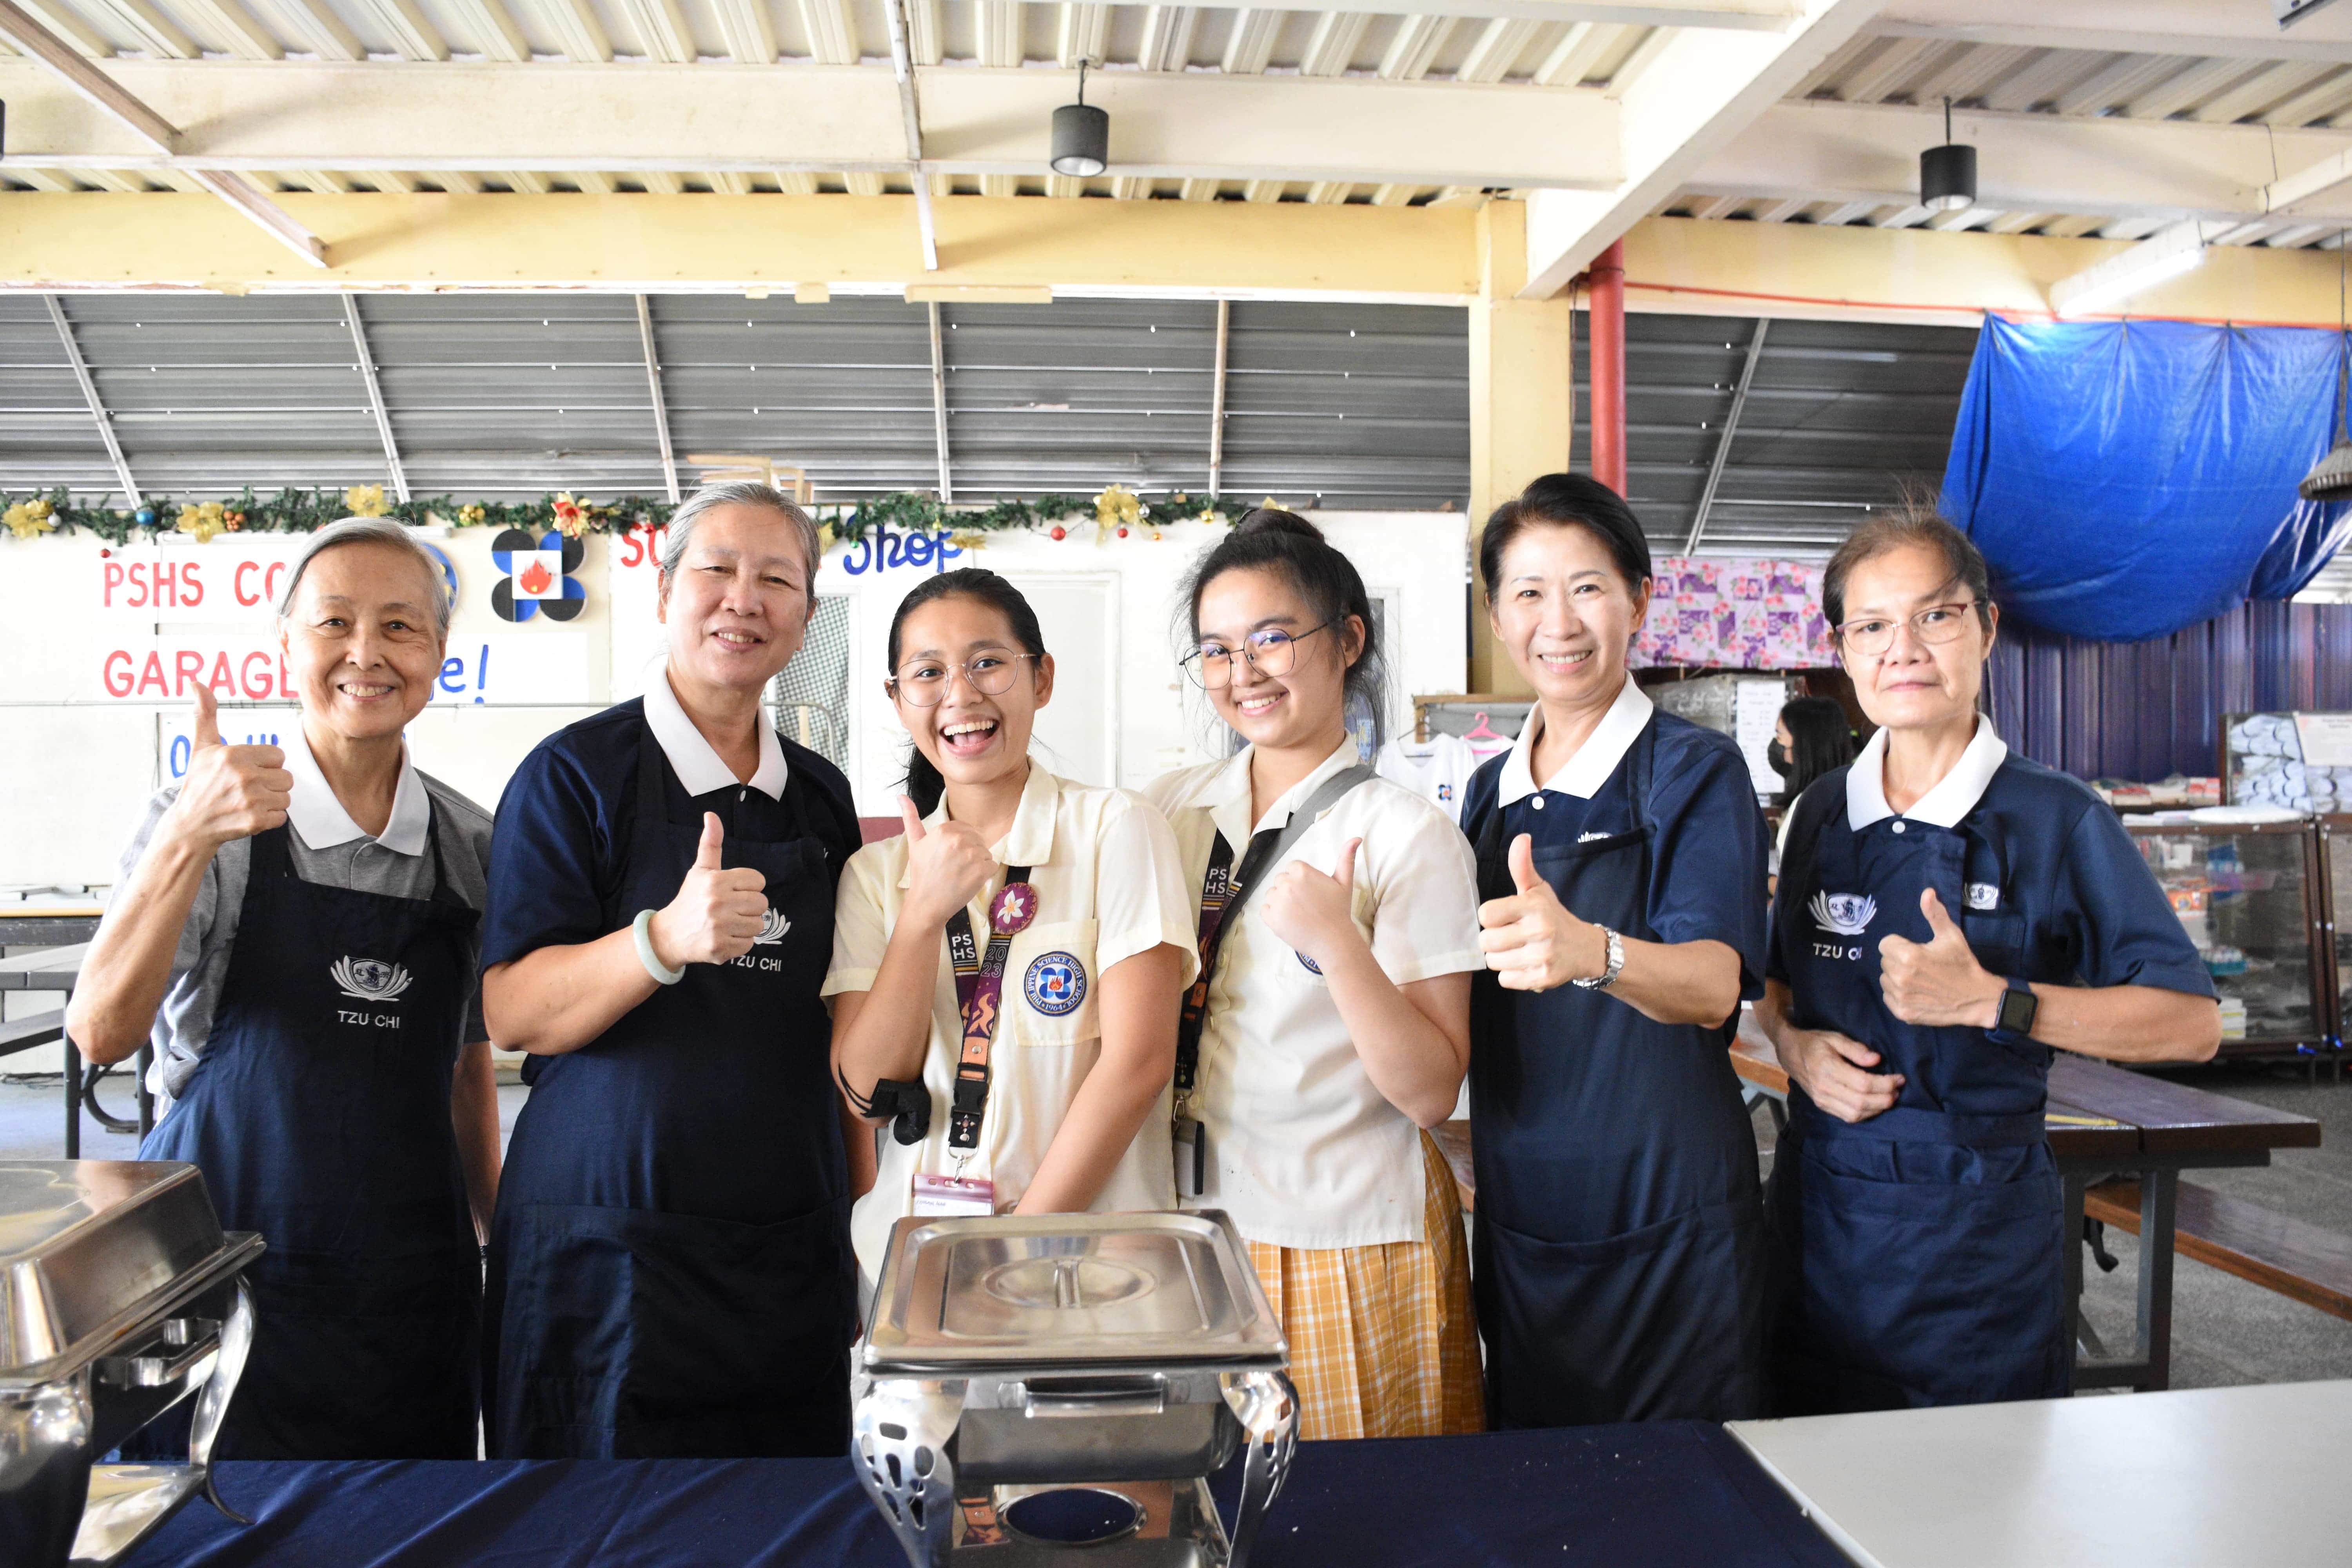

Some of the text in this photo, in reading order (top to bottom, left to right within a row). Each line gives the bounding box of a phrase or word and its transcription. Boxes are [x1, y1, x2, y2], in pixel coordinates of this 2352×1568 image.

[104, 562, 204, 607] PSHS
[1209, 868, 1227, 880] PS
[1205, 881, 1225, 893] HS
[952, 934, 972, 947] PS
[953, 947, 976, 960] HS
[984, 946, 1007, 961] 20
[1812, 942, 1842, 959] TZU
[759, 958, 781, 972] CHI
[980, 962, 1002, 978] 23
[1028, 956, 1083, 1007] PHILIPPINE SCIENCE HIGH SCHOOL
[338, 1010, 400, 1029] TZU CHI
